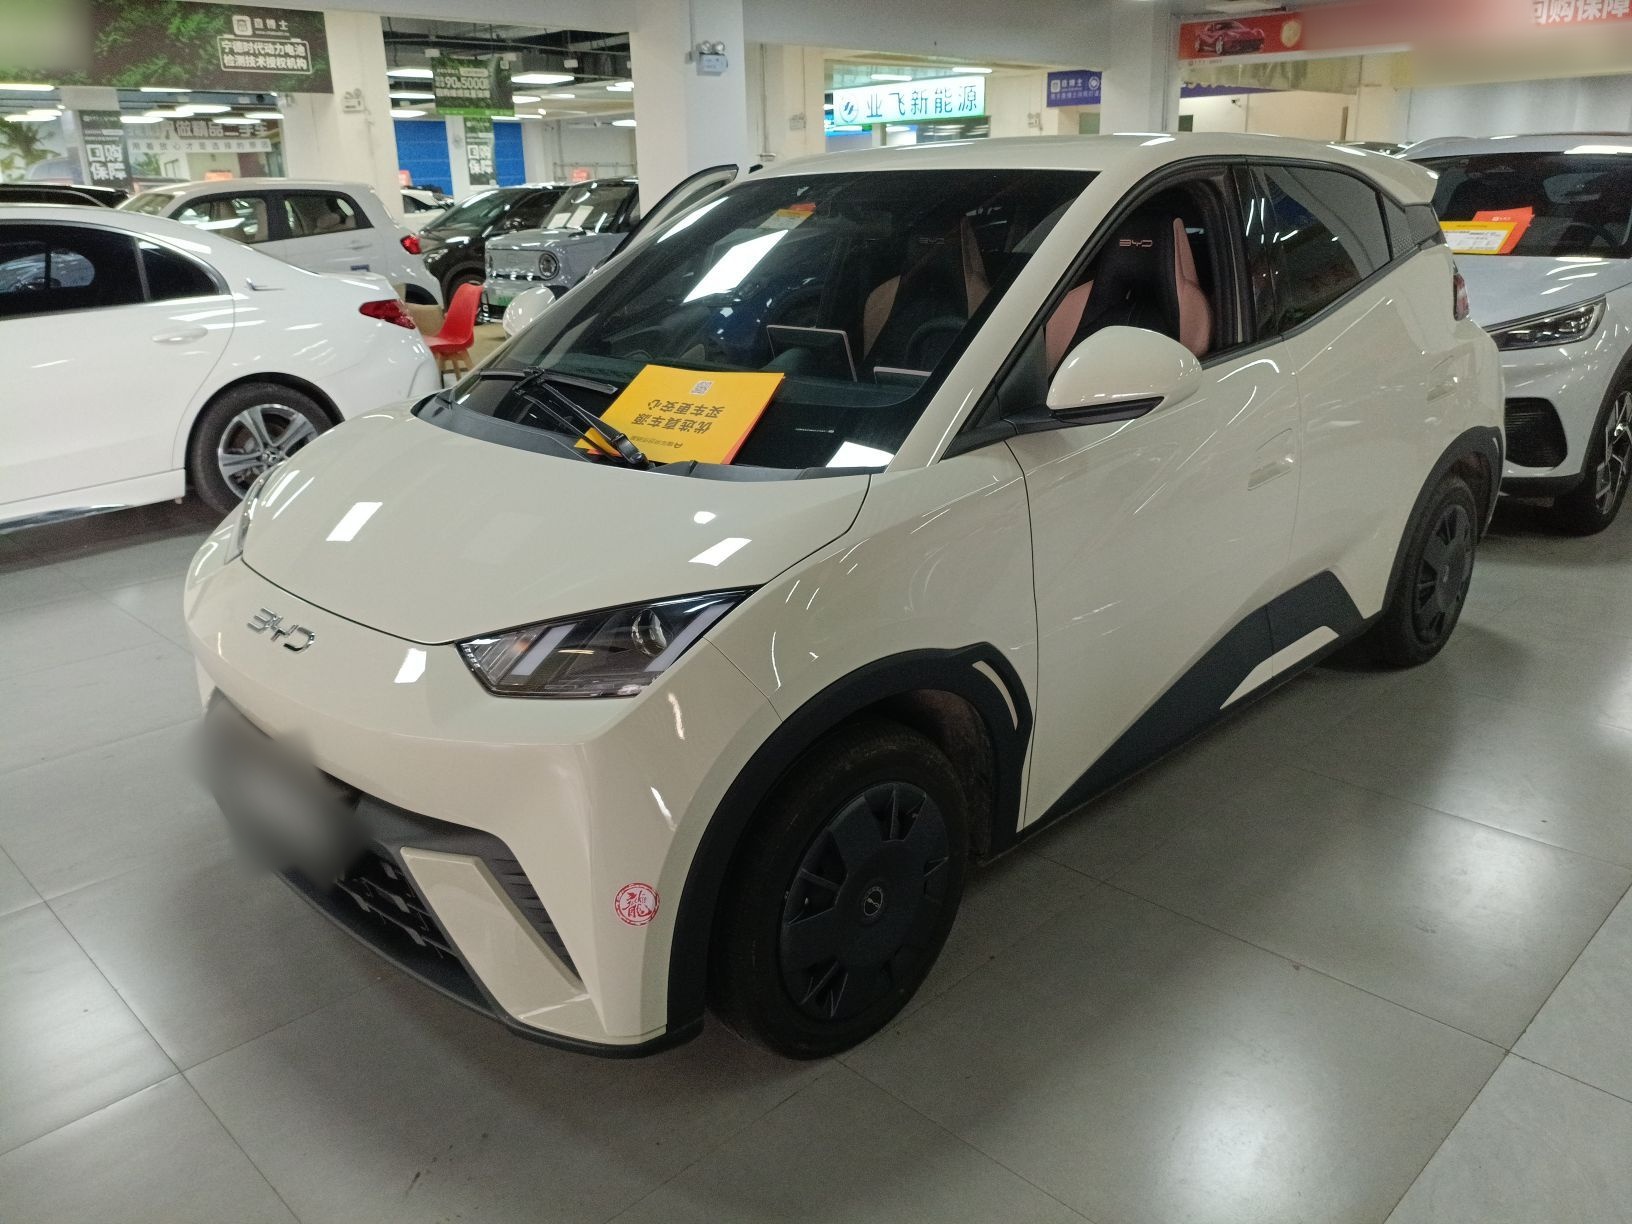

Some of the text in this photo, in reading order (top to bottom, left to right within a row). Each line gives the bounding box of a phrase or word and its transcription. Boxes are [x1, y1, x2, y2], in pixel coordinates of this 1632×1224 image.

[221, 40, 306, 57] 宁德时代动力电池
[223, 54, 308, 70] 检测技术授权机构
[866, 85, 977, 118] 业飞新能源
[86, 144, 123, 162] 回购
[91, 162, 127, 180] 保障
[1119, 239, 1153, 248] BYD
[647, 399, 725, 418] 买车更安心
[631, 413, 712, 434] 优选真车源
[247, 608, 315, 654] BYD
